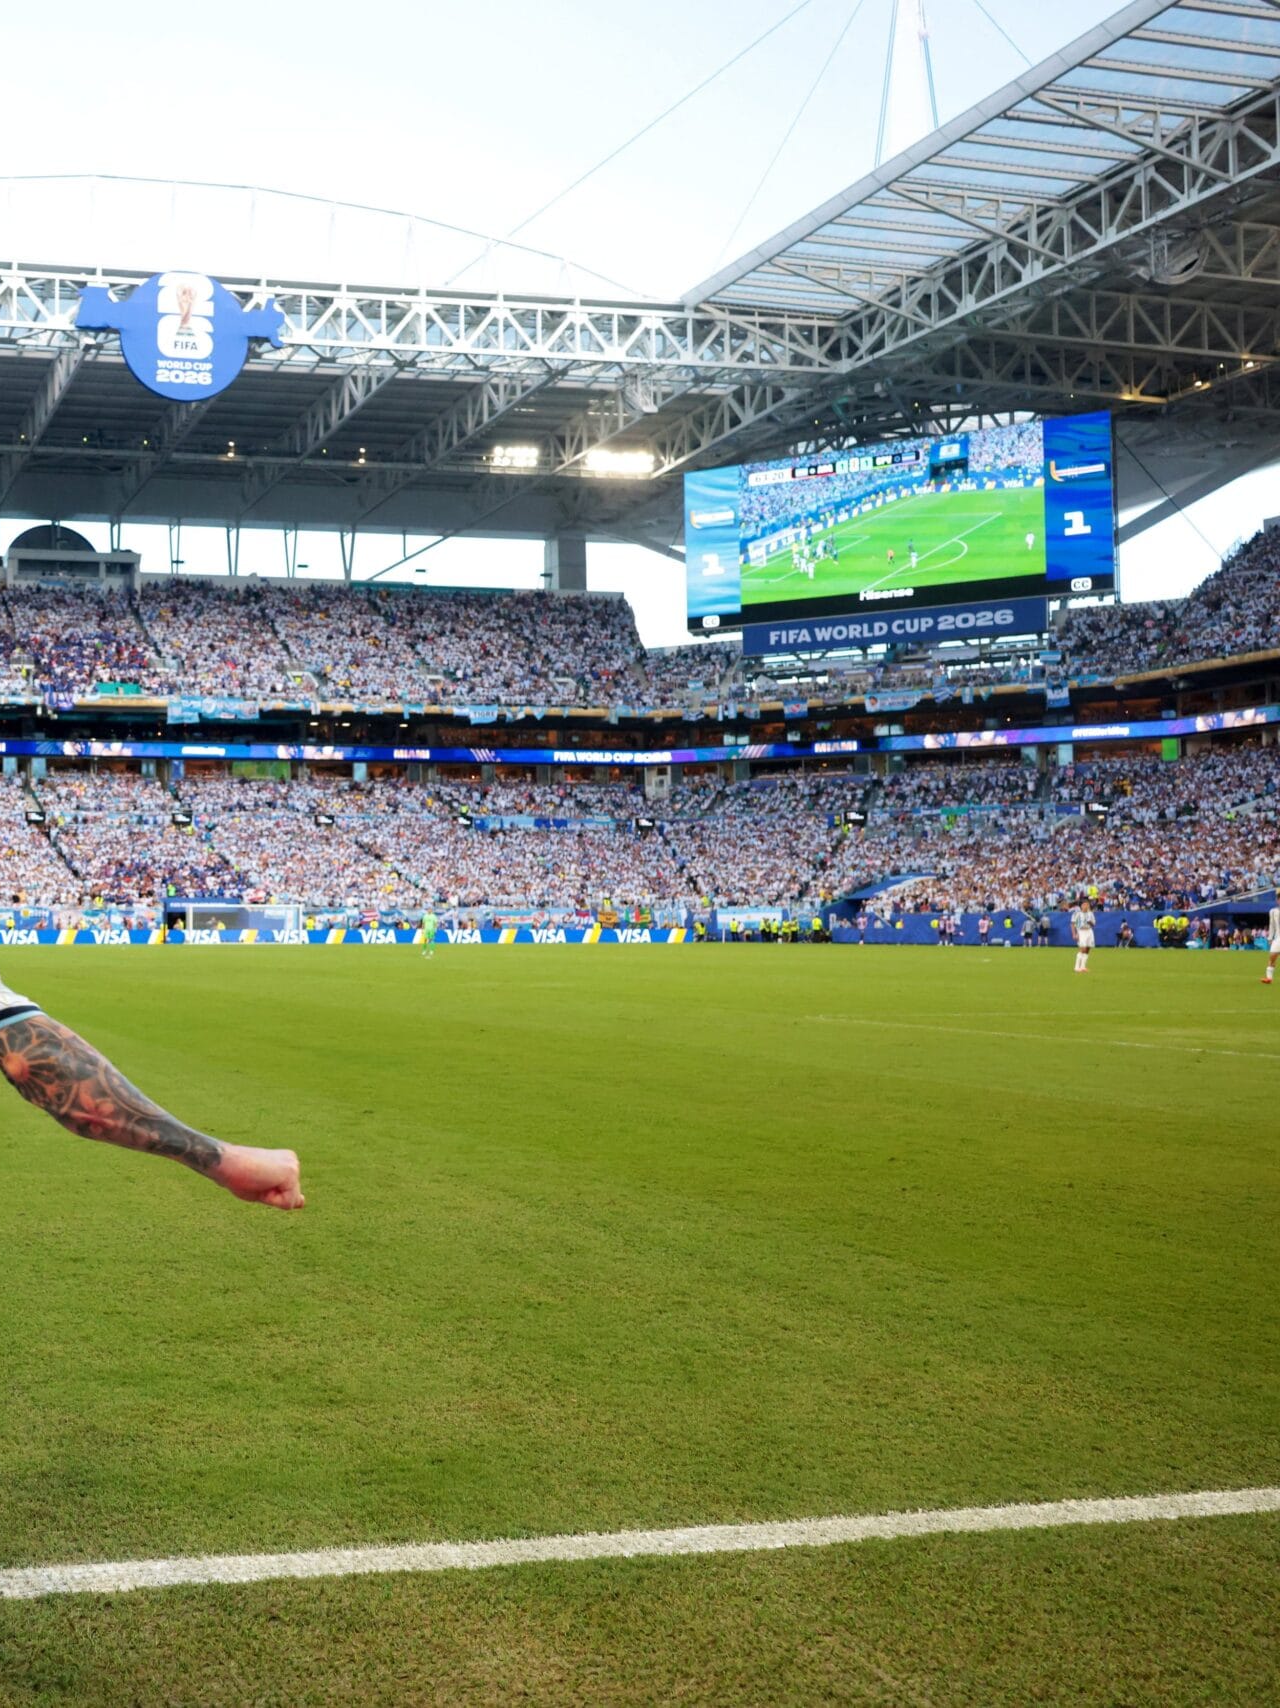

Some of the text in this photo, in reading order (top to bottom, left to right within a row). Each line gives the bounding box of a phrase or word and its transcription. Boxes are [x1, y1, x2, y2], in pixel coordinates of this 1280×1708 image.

[173, 340, 198, 351] FIFA
[157, 360, 213, 371] WORLD CUP
[156, 369, 212, 385] 2026
[1063, 510, 1092, 537] 1
[701, 553, 725, 576] 1
[859, 586, 914, 602] Hisense
[769, 609, 1014, 646] FIFA WORLD CUP 2026
[814, 739, 859, 753] MIAMI
[393, 748, 430, 760] MIAMI
[553, 751, 672, 764] FIFA WORLD CUP 2026
[92, 930, 131, 945] VISA
[183, 929, 221, 945] VISA
[271, 930, 310, 945] VISA
[358, 929, 397, 944] VISA
[444, 929, 482, 944] VISA
[530, 929, 566, 944] VISA
[615, 929, 652, 944] VISA
